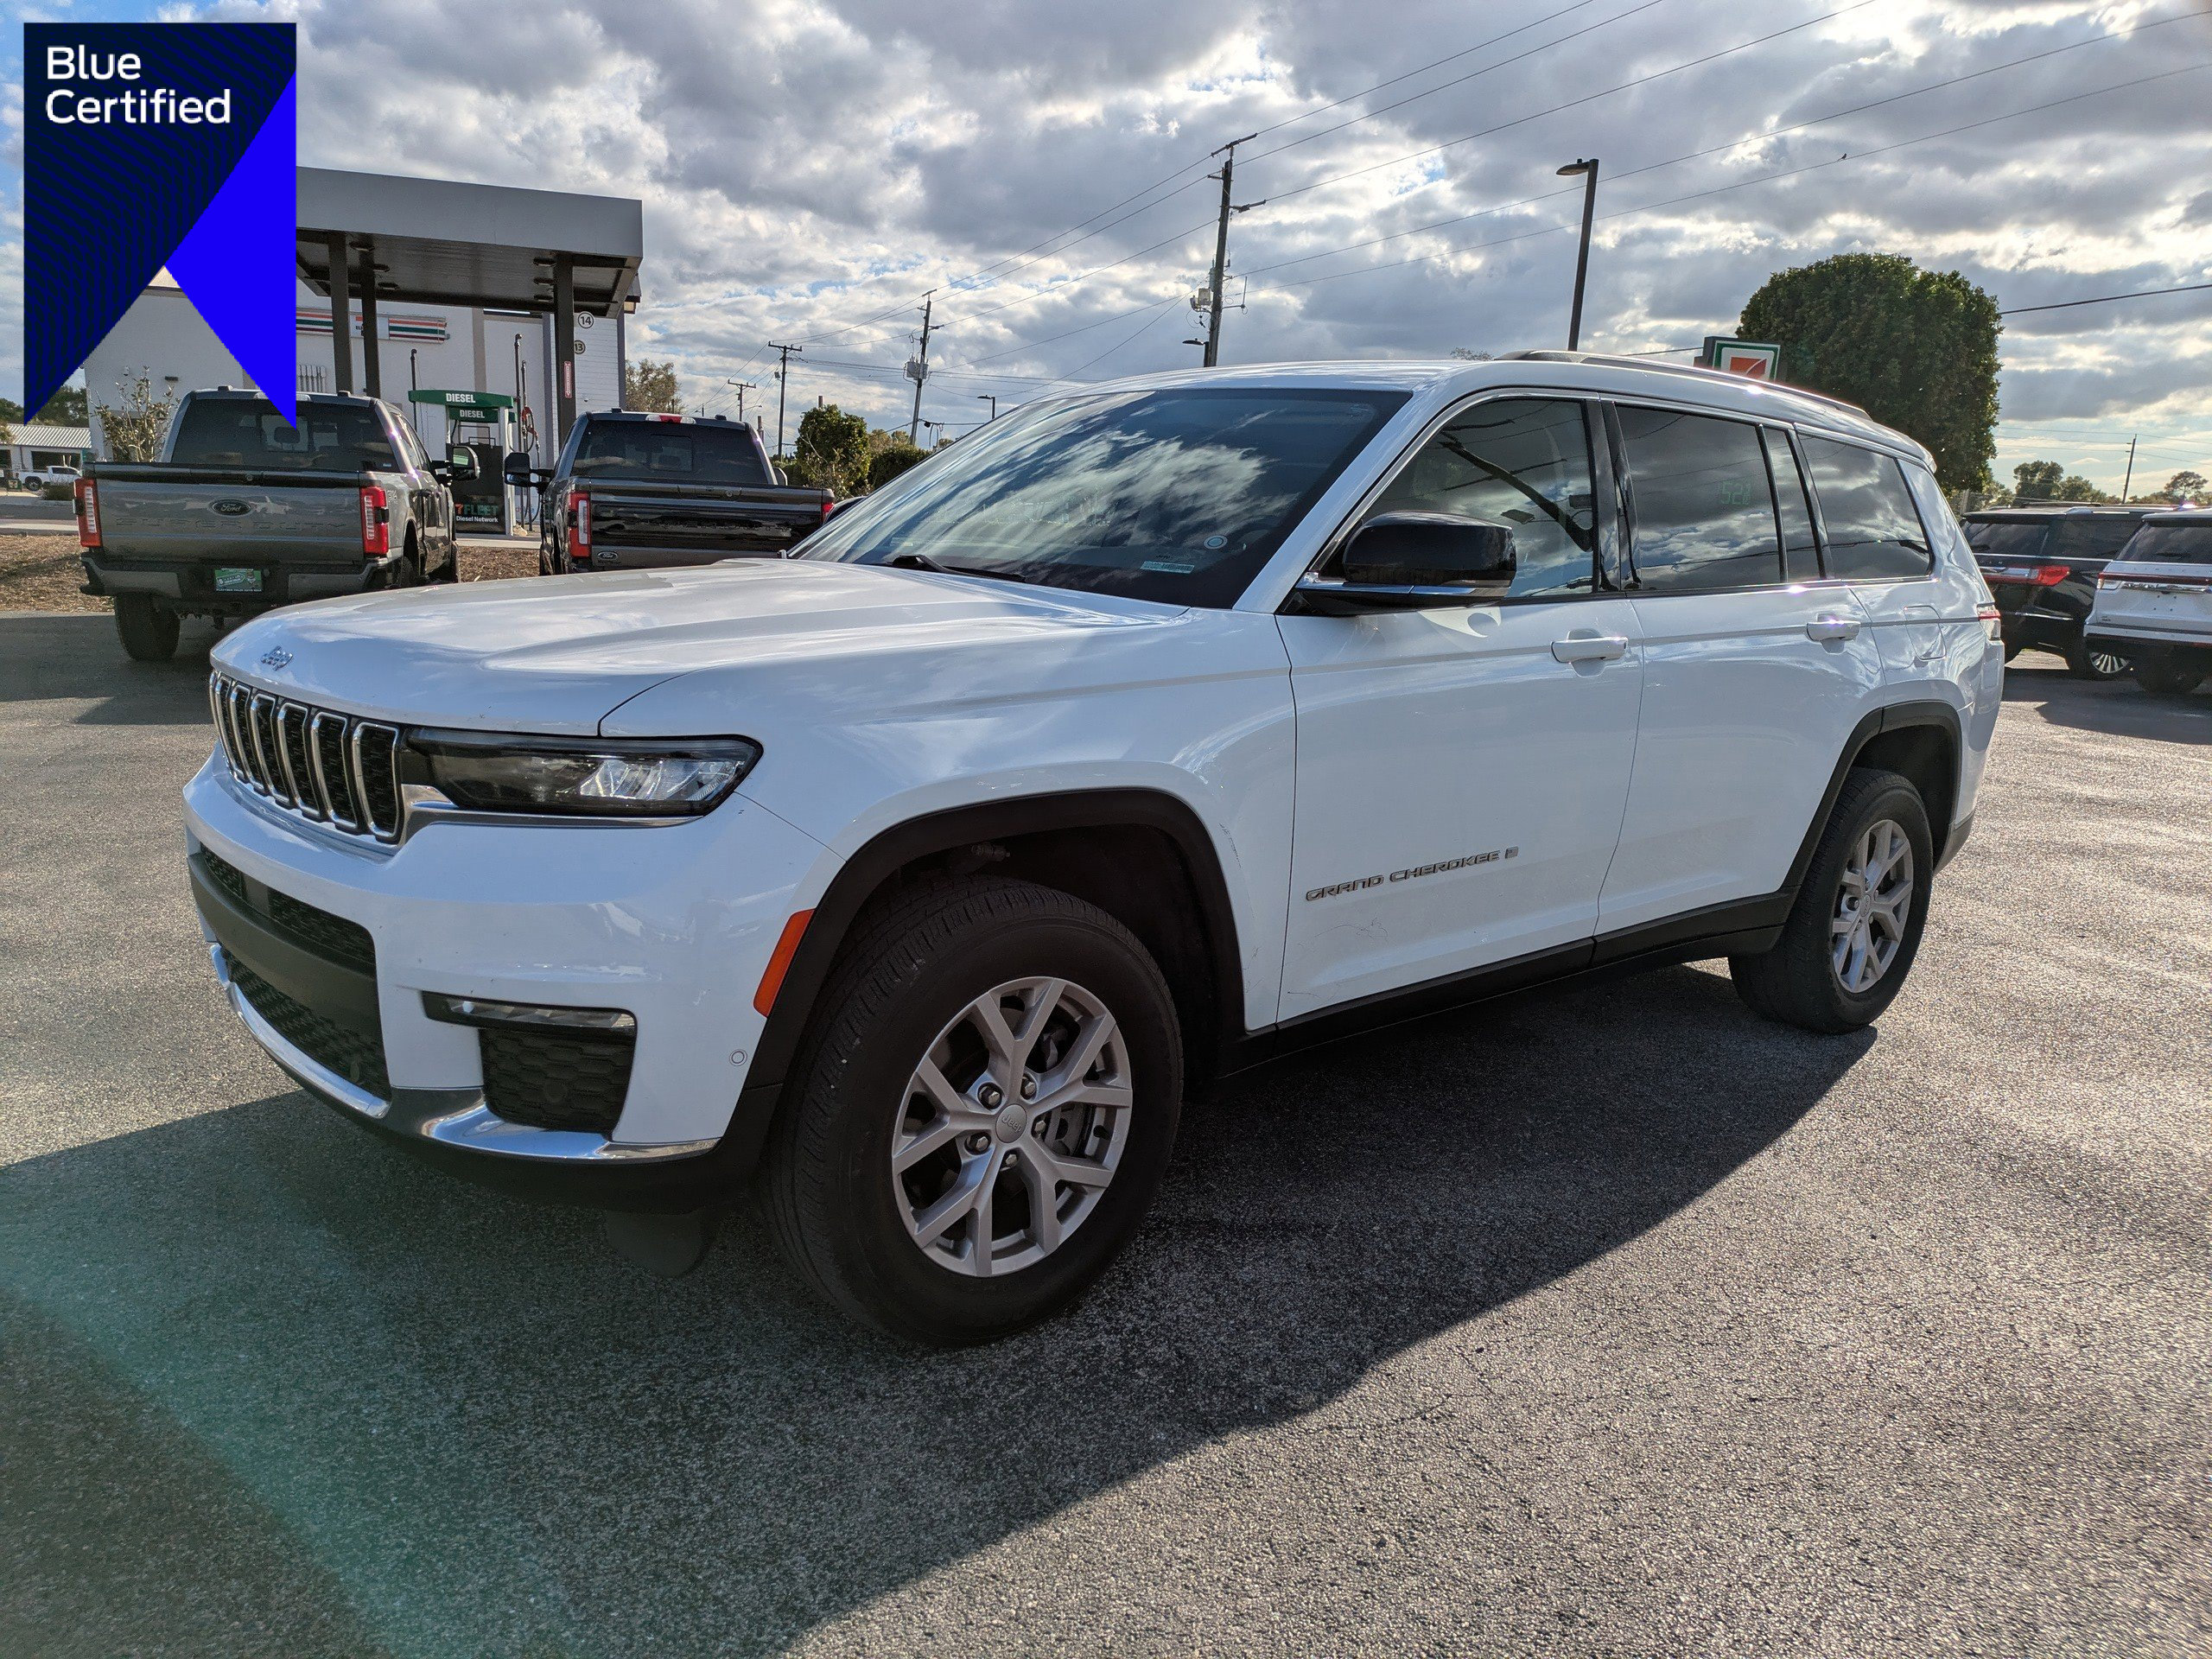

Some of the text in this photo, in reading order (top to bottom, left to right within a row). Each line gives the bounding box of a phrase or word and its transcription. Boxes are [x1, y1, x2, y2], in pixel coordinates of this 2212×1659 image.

[580, 315, 592, 325] 14
[574, 343, 583, 352] 13
[446, 393, 476, 404] DIESEL
[460, 410, 486, 418] DIESEL
[220, 502, 242, 512] Ford
[260, 645, 294, 671] Jeep
[1306, 874, 1384, 901] GRAND
[1389, 850, 1500, 883] CHEROKEE
[1001, 1114, 1021, 1133] Jeep
